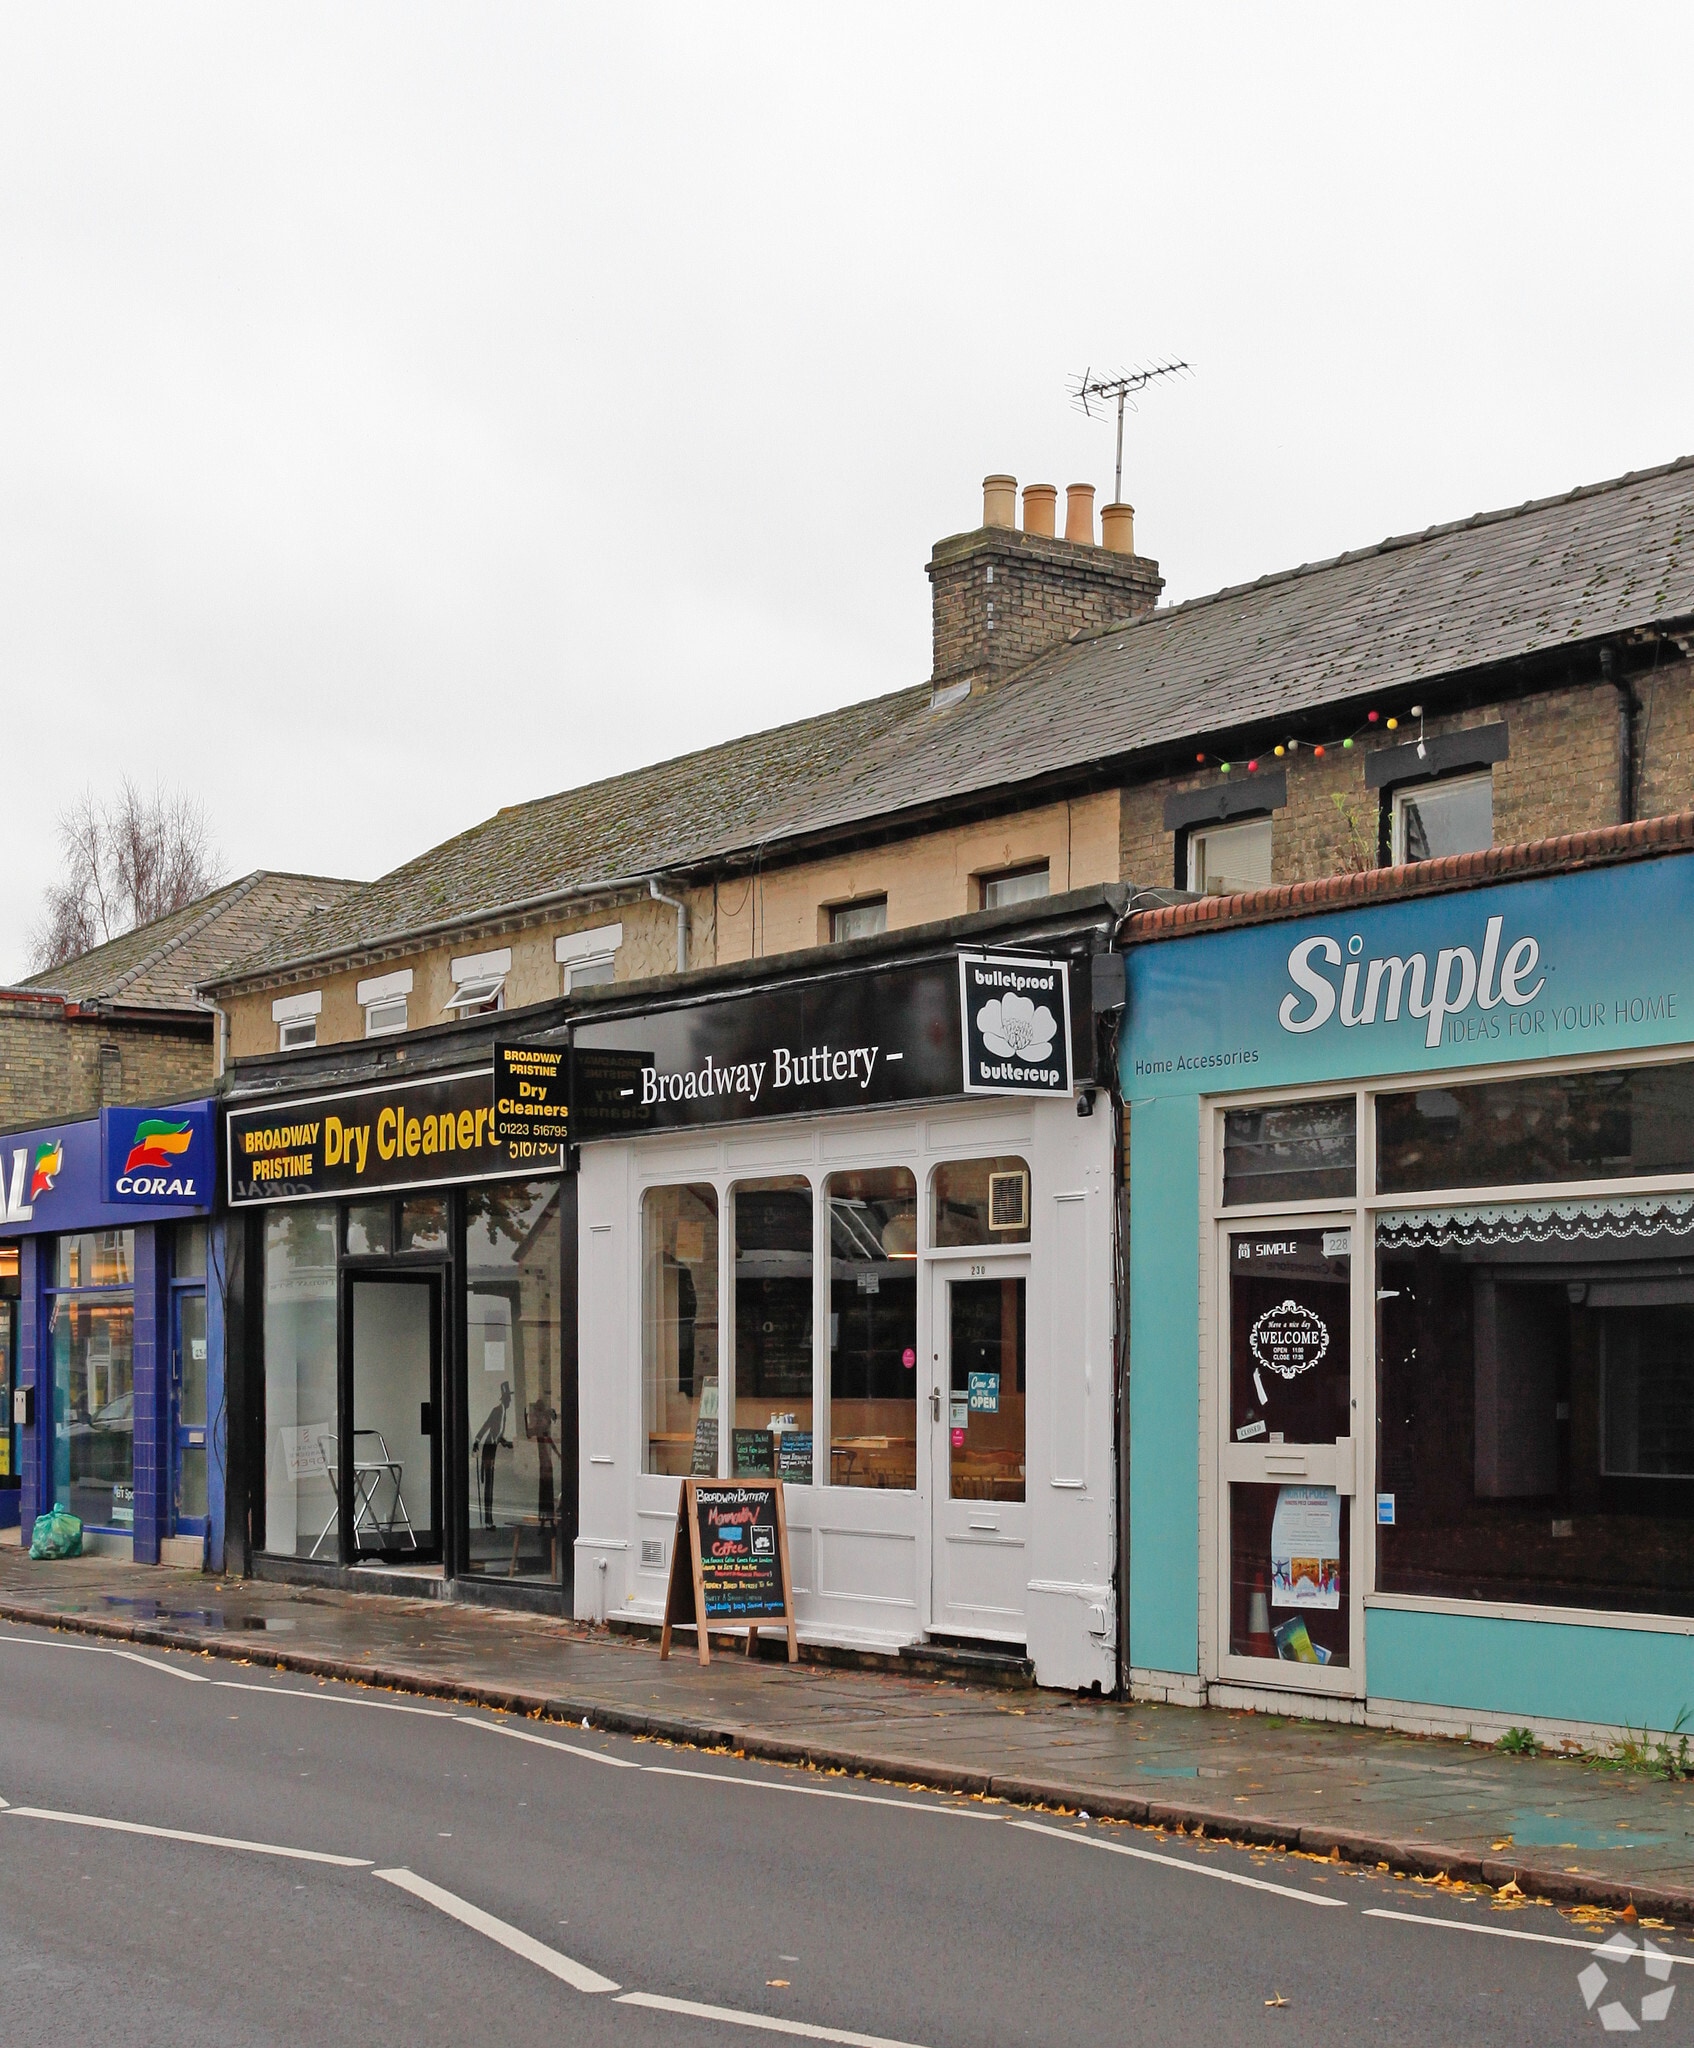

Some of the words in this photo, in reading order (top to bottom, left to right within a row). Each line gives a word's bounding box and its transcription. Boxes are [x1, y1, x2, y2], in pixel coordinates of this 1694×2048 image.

[974, 969, 1054, 991] bulletproof
[1278, 915, 1547, 1048] Simple
[1447, 1014, 1500, 1043] IDEAS
[1508, 1009, 1544, 1038] FOR
[1552, 1002, 1605, 1032] YOUR
[1614, 992, 1678, 1023] HOME
[504, 1049, 562, 1064] BROADWAY
[1135, 1056, 1173, 1076] Home
[1176, 1047, 1260, 1073] Accessories
[509, 1063, 557, 1077] PRISTINE
[640, 1055, 767, 1105] Broadway
[772, 1045, 879, 1089] Buttery
[980, 1061, 1060, 1087] buttercup
[519, 1081, 548, 1101] Dry
[497, 1099, 569, 1117] Cleaners
[245, 1122, 320, 1153] BROADWAY
[499, 1122, 530, 1136] 01223
[533, 1124, 568, 1137] 516795
[325, 1116, 370, 1174] Dry
[252, 1153, 313, 1181] PRISTINE
[116, 1177, 197, 1196] CORAL
[1255, 1242, 1297, 1257] SIMPLE
[1328, 1238, 1348, 1251] 228
[971, 1265, 986, 1275] 230
[1259, 1331, 1320, 1344] WELCOME
[971, 1376, 986, 1389] Come
[970, 1396, 996, 1409] OPEN
[1240, 1424, 1262, 1436] CLOSED
[712, 1540, 748, 1556] Coffee
